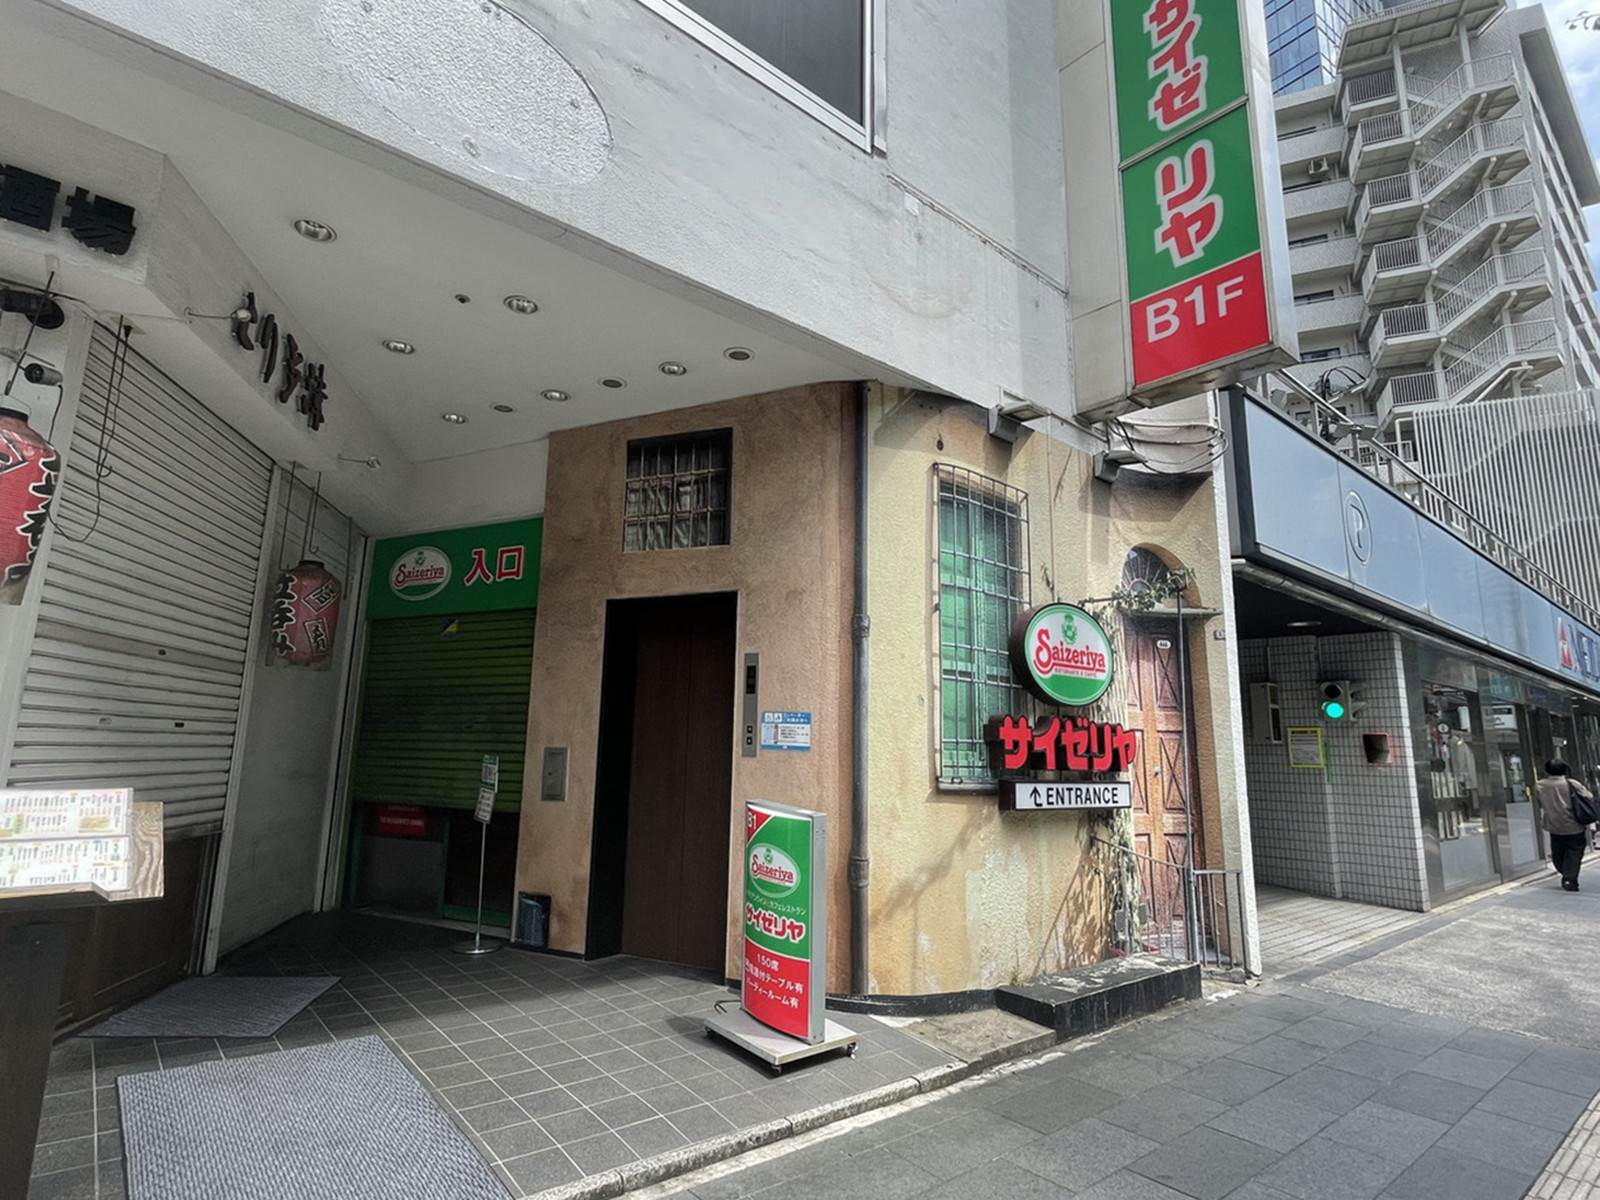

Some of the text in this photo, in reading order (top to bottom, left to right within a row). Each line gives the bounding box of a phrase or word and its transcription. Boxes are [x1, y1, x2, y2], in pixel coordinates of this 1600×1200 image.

[1145, 0, 1219, 264] サイゼリヤ
[1145, 274, 1245, 344] B1F
[393, 563, 445, 588] Saizeriya
[463, 544, 525, 587] 入口
[1034, 628, 1106, 675] Saizeriya
[1000, 714, 1137, 772] サイゼリヤ
[1046, 786, 1119, 805] ENTRANCE
[752, 853, 794, 884] Saizeriya
